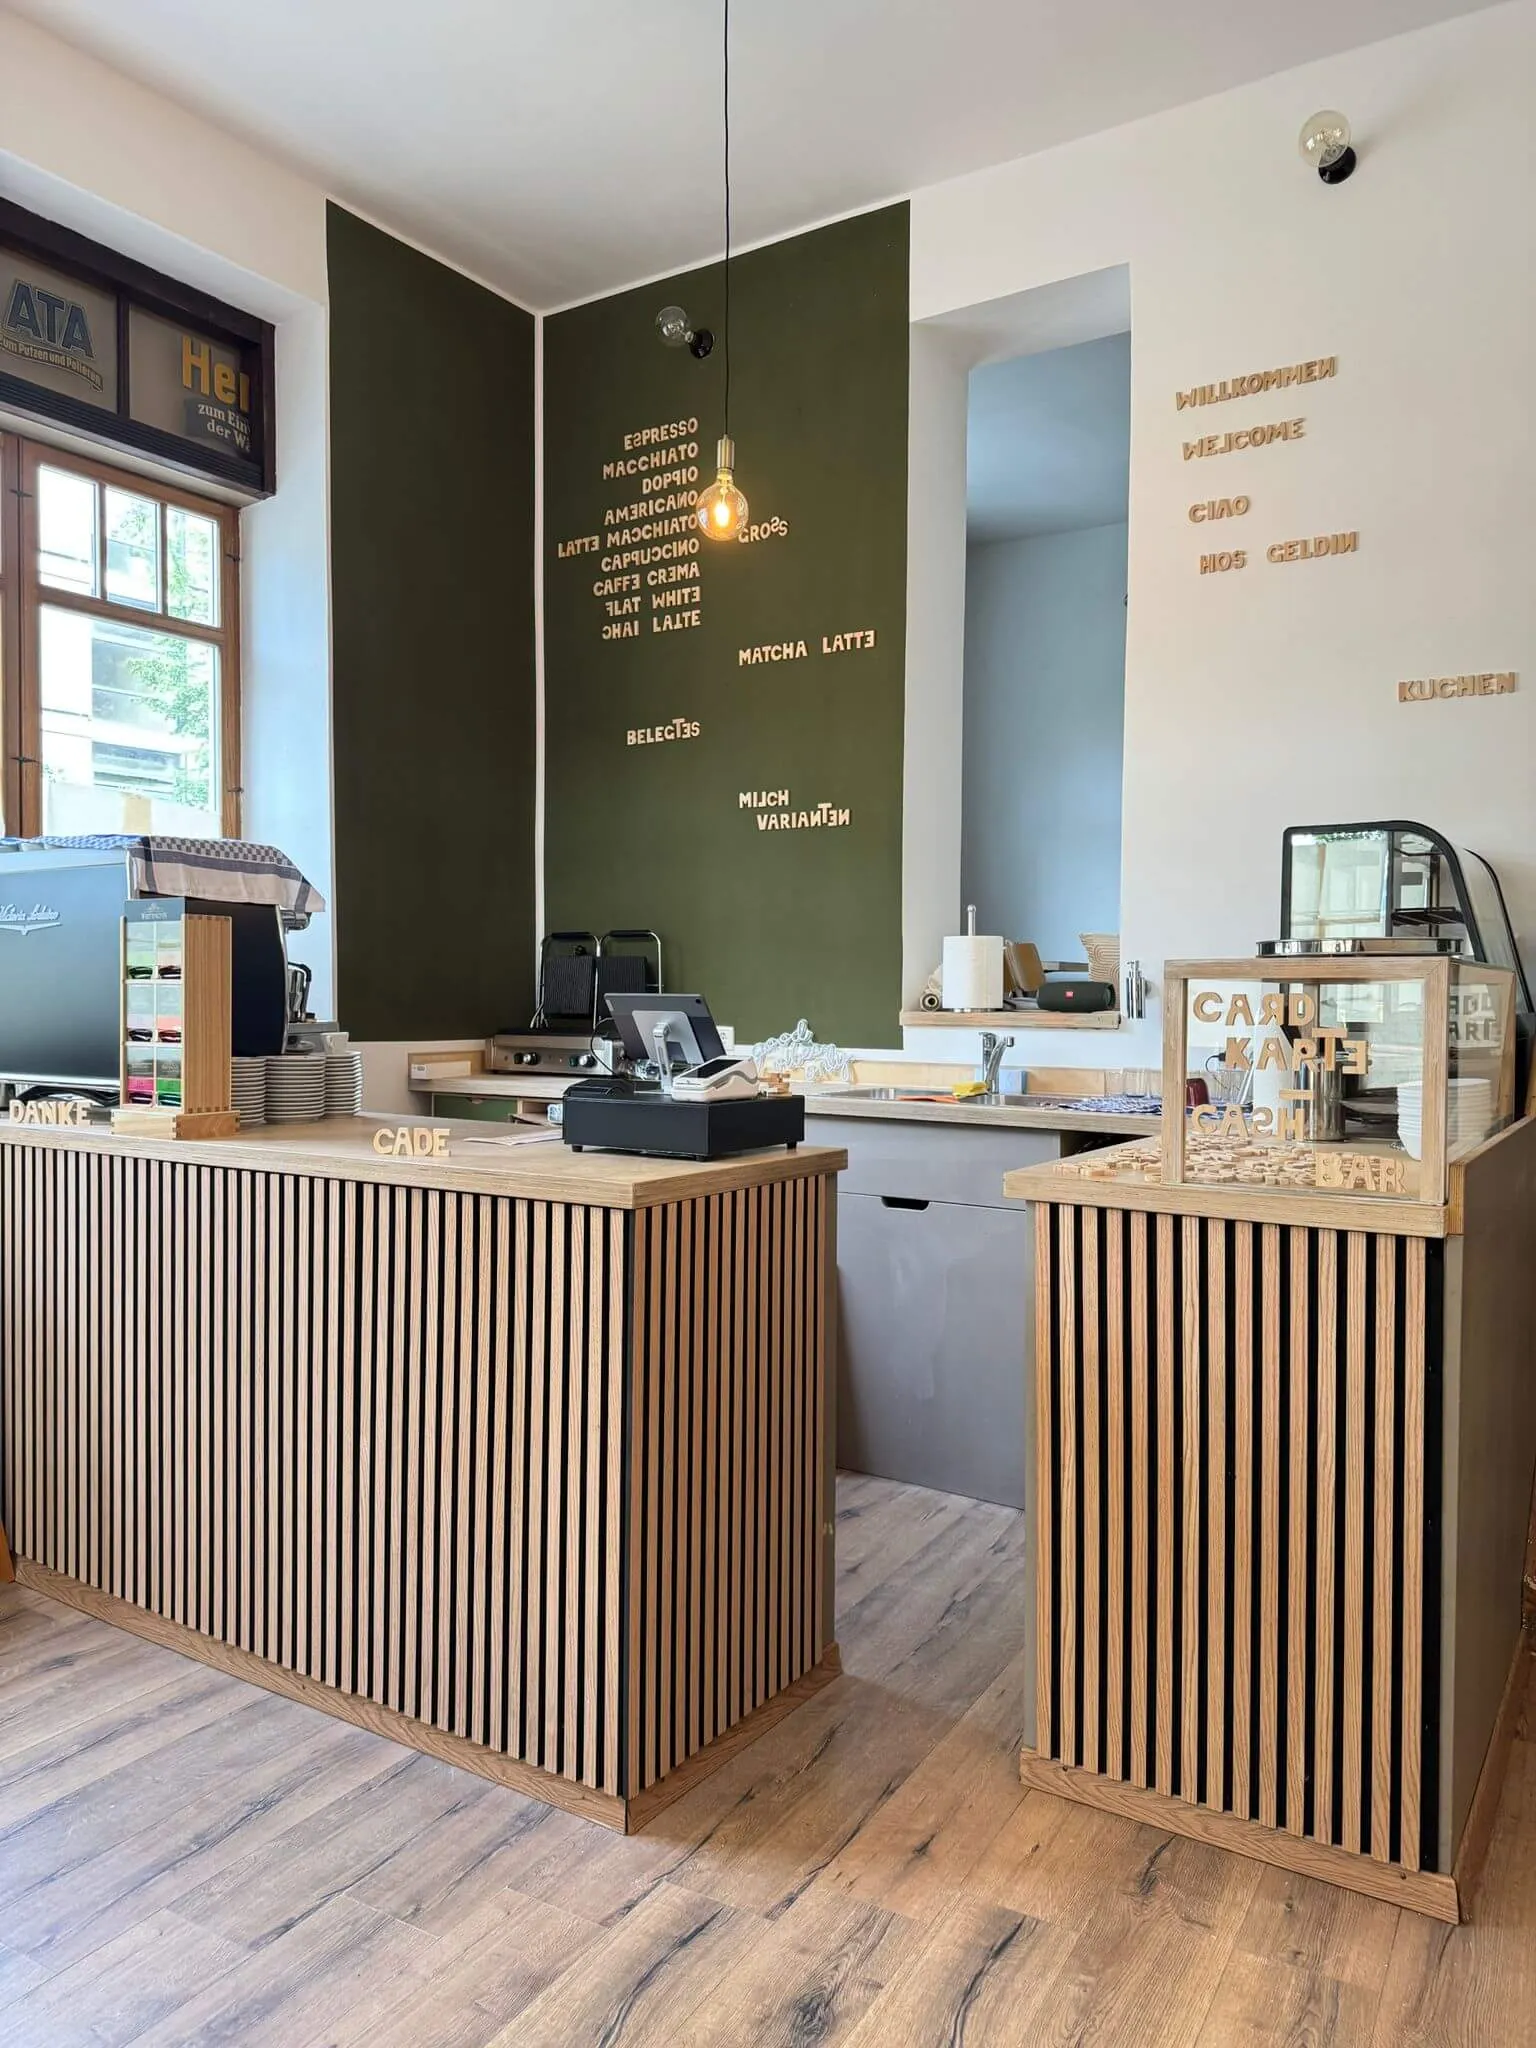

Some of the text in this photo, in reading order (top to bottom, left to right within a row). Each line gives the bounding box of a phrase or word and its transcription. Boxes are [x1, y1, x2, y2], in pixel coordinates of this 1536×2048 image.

[6, 281, 95, 358] ATA
[1176, 356, 1338, 411] WILLKOMMEN
[198, 403, 226, 421] zum
[206, 419, 232, 439] der
[624, 417, 698, 450] ESPRESSO
[1183, 418, 1306, 460] WELCOME
[603, 441, 698, 480] MACCHIATO
[642, 466, 698, 495] DOPPIO
[604, 490, 698, 526] AMERICANO
[1188, 495, 1250, 523] CIAO
[558, 515, 698, 558] LATTE MACCHIATO
[738, 516, 788, 544] GROSS
[601, 538, 699, 572] CAPPUCCINO
[1200, 531, 1359, 575] HOS GELDIN
[593, 561, 700, 598] CAFFE CREMA
[605, 586, 700, 617] FLAT WHITE
[602, 609, 700, 640] CHAI LATTE
[739, 630, 875, 666] MATCHA LATTE
[1399, 671, 1517, 703] KUCHEN
[739, 789, 789, 809] MILCH
[757, 803, 850, 831] VARIANTEN
[1193, 992, 1316, 1027] CARD
[1224, 1027, 1370, 1075] KARTE
[9, 1099, 93, 1127] DANKE
[1191, 1104, 1306, 1141] CASH
[372, 1126, 451, 1158] CADE
[1315, 1151, 1407, 1194] BAR
